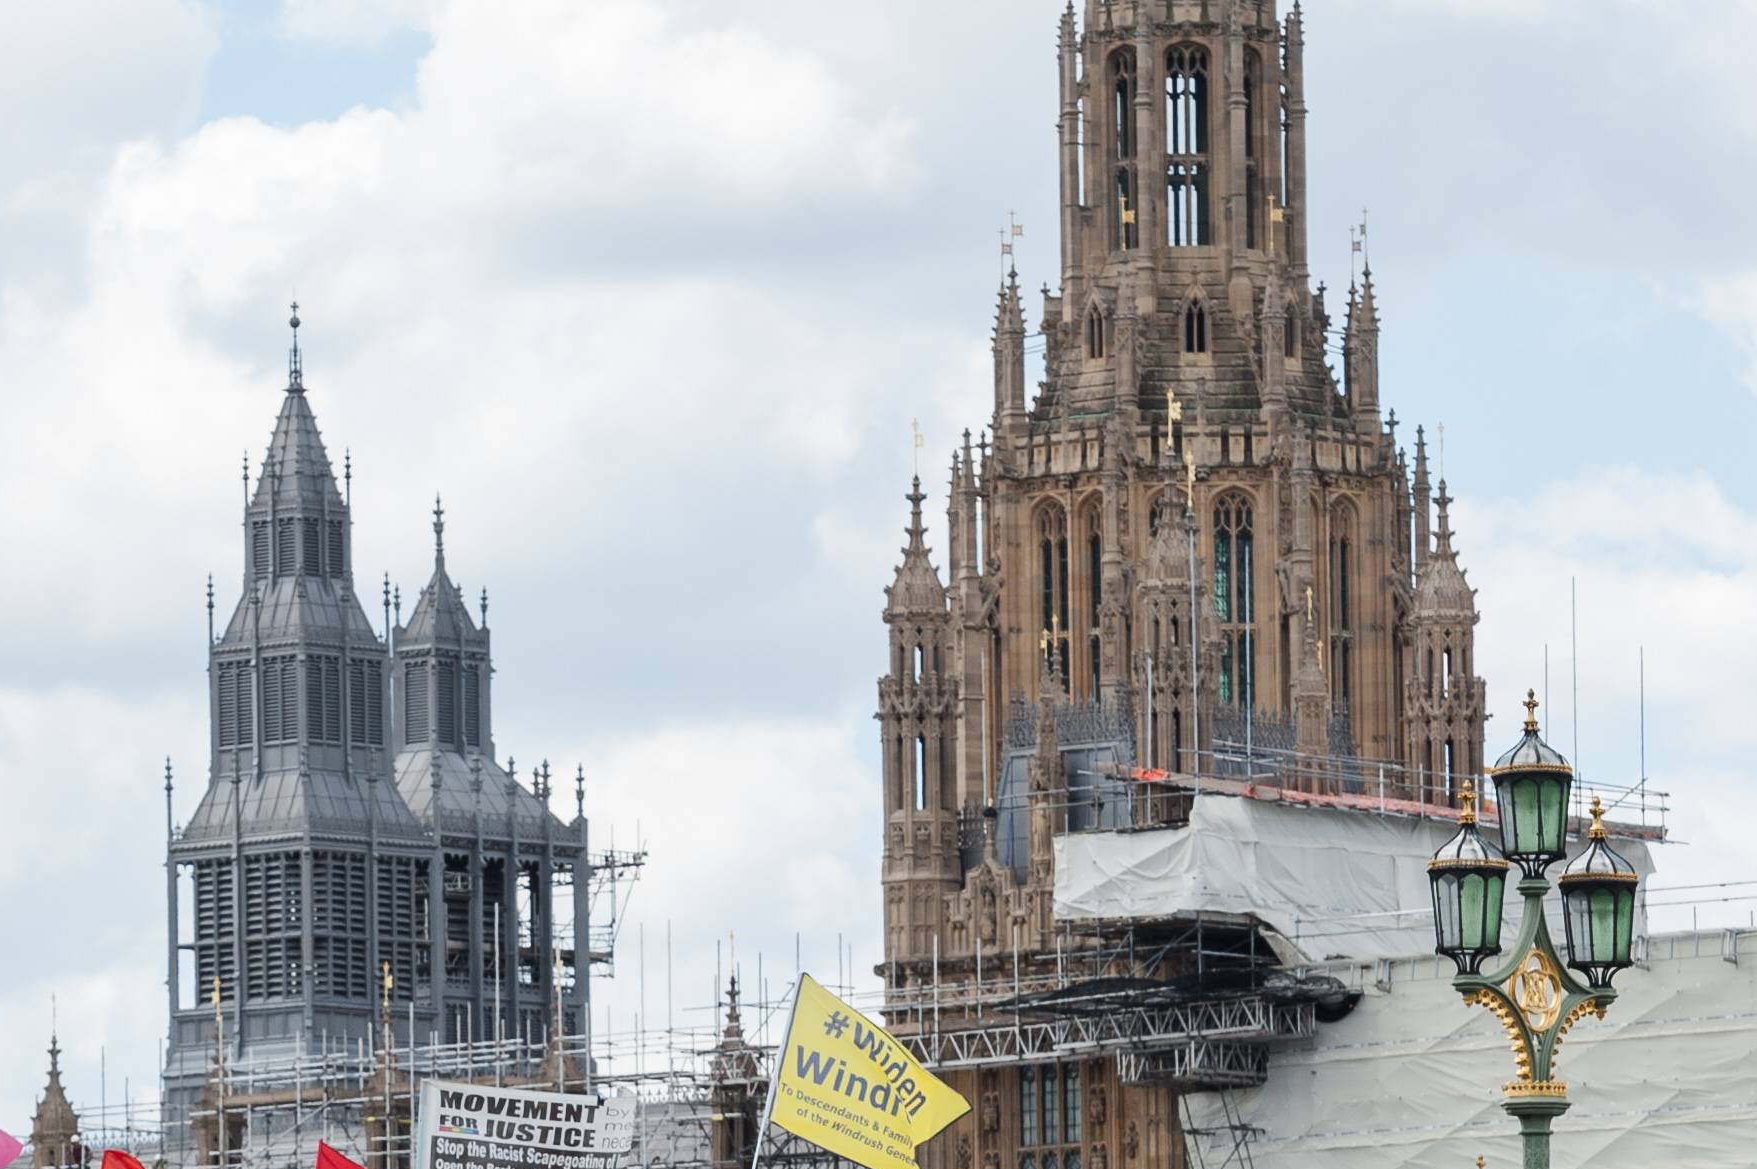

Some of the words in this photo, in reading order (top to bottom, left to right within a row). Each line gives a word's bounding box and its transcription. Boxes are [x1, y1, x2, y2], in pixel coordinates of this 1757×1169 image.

[797, 1045, 904, 1117] Windr
[439, 1090, 599, 1123] MOVEMENT
[781, 1083, 793, 1096] To
[796, 1090, 869, 1127] Descendants
[439, 1115, 478, 1128] FOR
[484, 1119, 596, 1148] JUSTICE
[796, 1108, 808, 1118] of
[811, 1112, 829, 1126] the
[832, 1121, 883, 1151] Windrush
[436, 1138, 464, 1159] Stop
[467, 1141, 487, 1158] the
[489, 1143, 524, 1163] Racist
[606, 1153, 617, 1168] of
